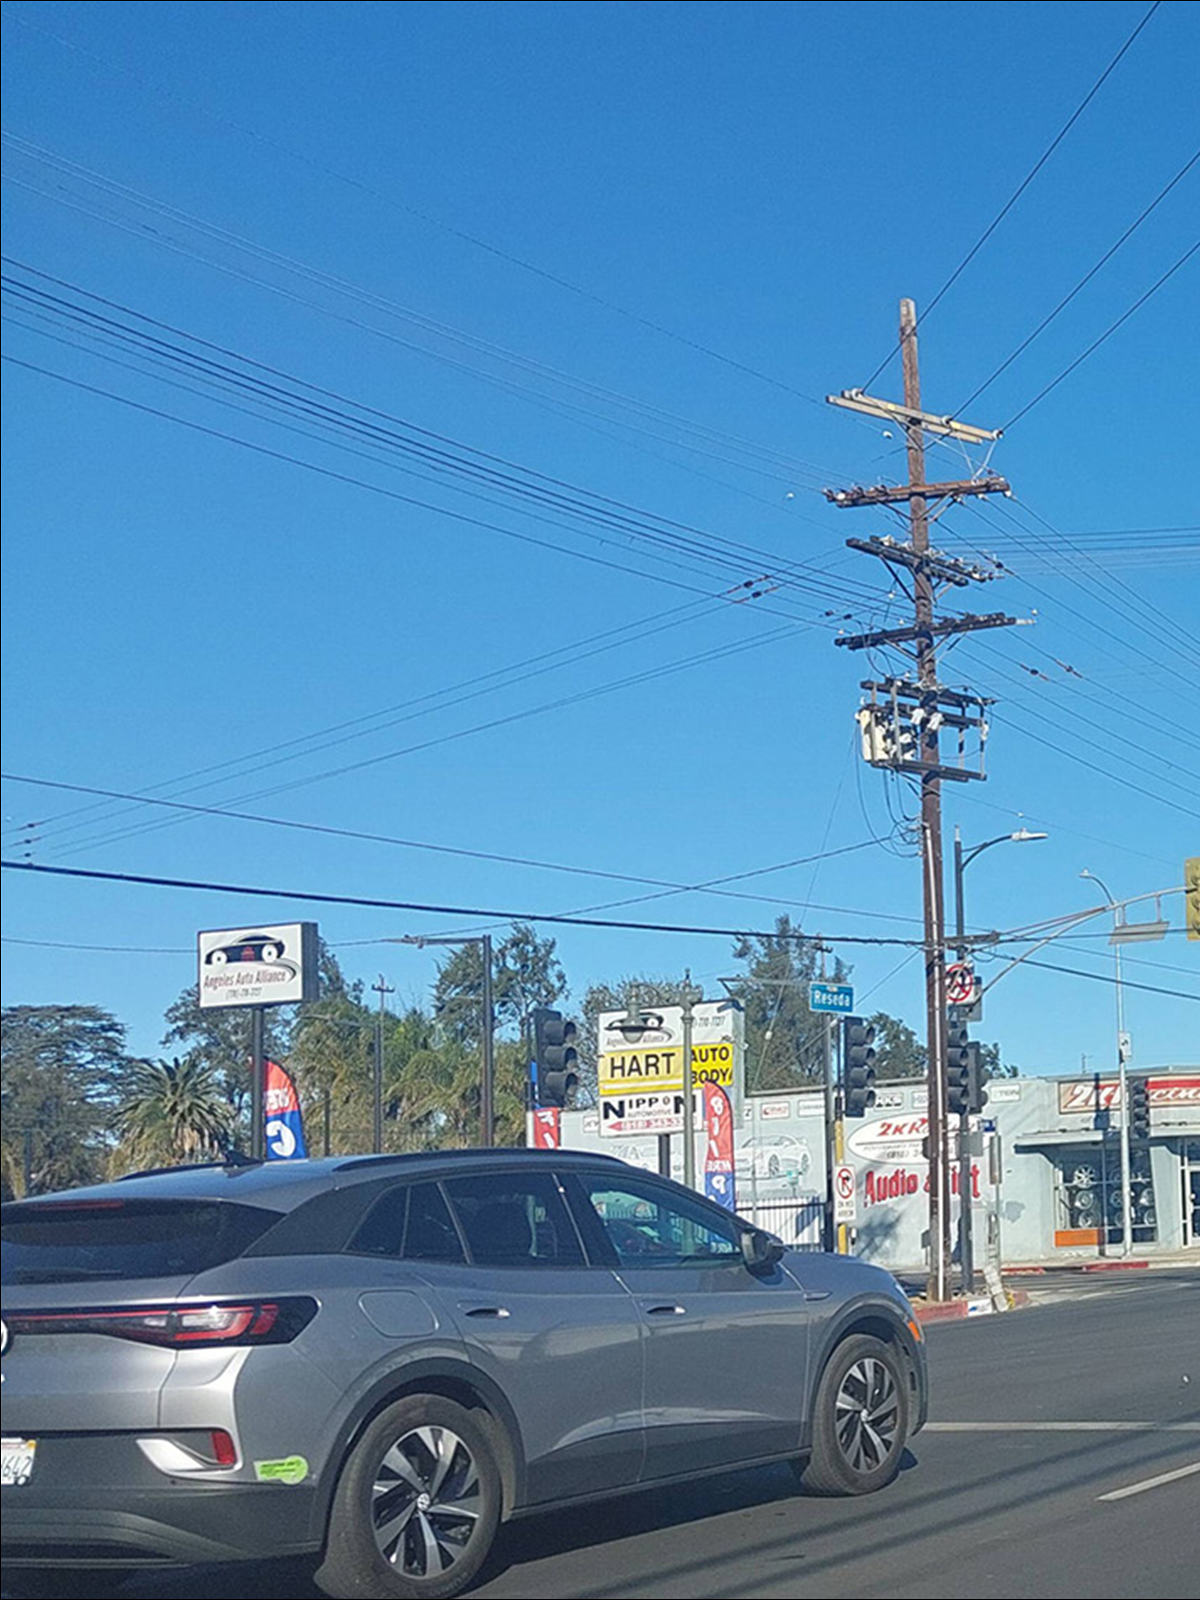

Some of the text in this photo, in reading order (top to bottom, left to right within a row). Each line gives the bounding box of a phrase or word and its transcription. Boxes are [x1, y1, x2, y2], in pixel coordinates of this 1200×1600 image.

[204, 968, 287, 991] Angeles Auto Alliance
[814, 989, 850, 1007] Reseda
[610, 1053, 675, 1078] HART
[692, 1047, 729, 1063] AUTO
[692, 1068, 729, 1085] BODY
[603, 1095, 696, 1120] NIPPON
[865, 1169, 918, 1208] Audio
